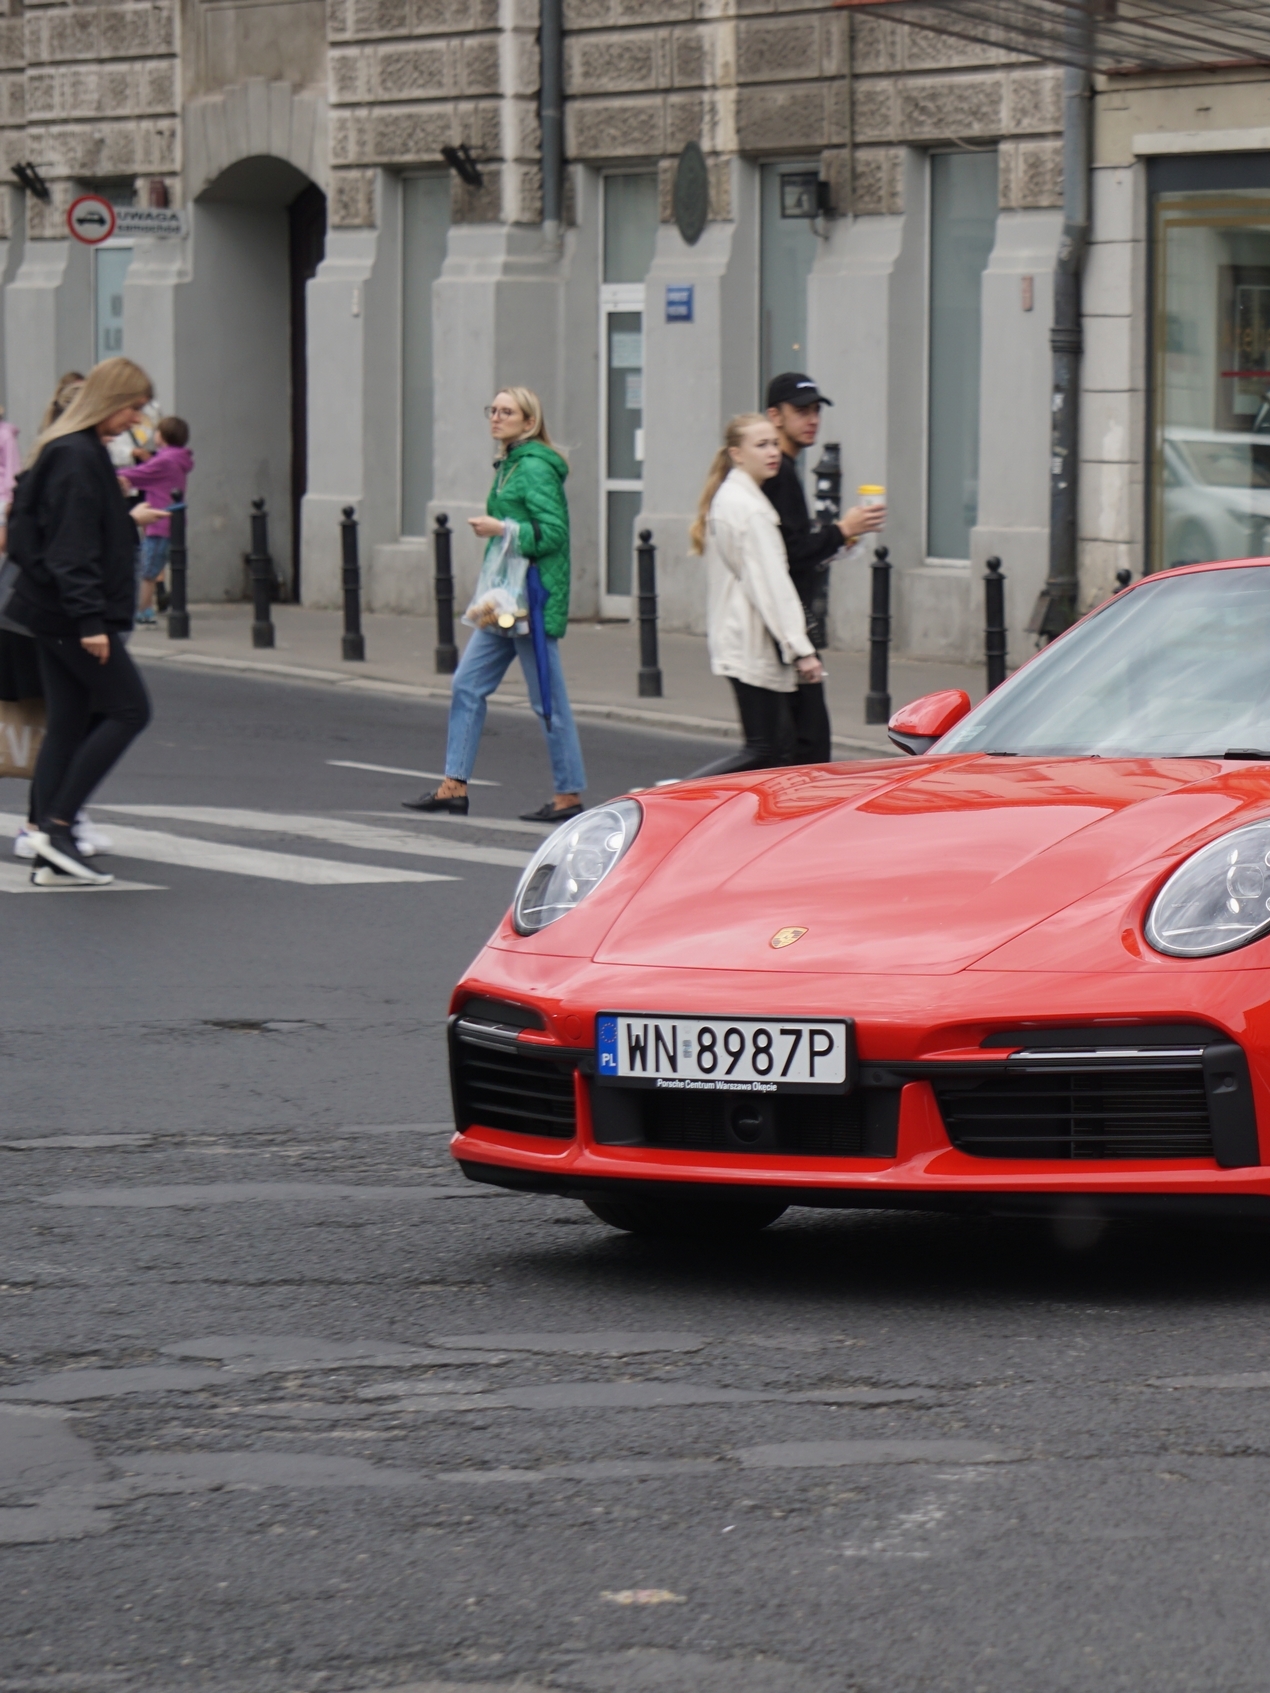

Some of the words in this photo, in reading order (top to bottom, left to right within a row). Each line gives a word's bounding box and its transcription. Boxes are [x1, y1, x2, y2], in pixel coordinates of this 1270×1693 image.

[116, 210, 179, 222] UWAGA
[626, 1022, 678, 1073] WN
[697, 1025, 835, 1078] 8987P
[601, 1053, 617, 1067] PL
[657, 1078, 684, 1088] Porsche
[685, 1080, 715, 1089] Centrum
[716, 1081, 752, 1091] Warszawa
[752, 1082, 778, 1093] Okęcie
